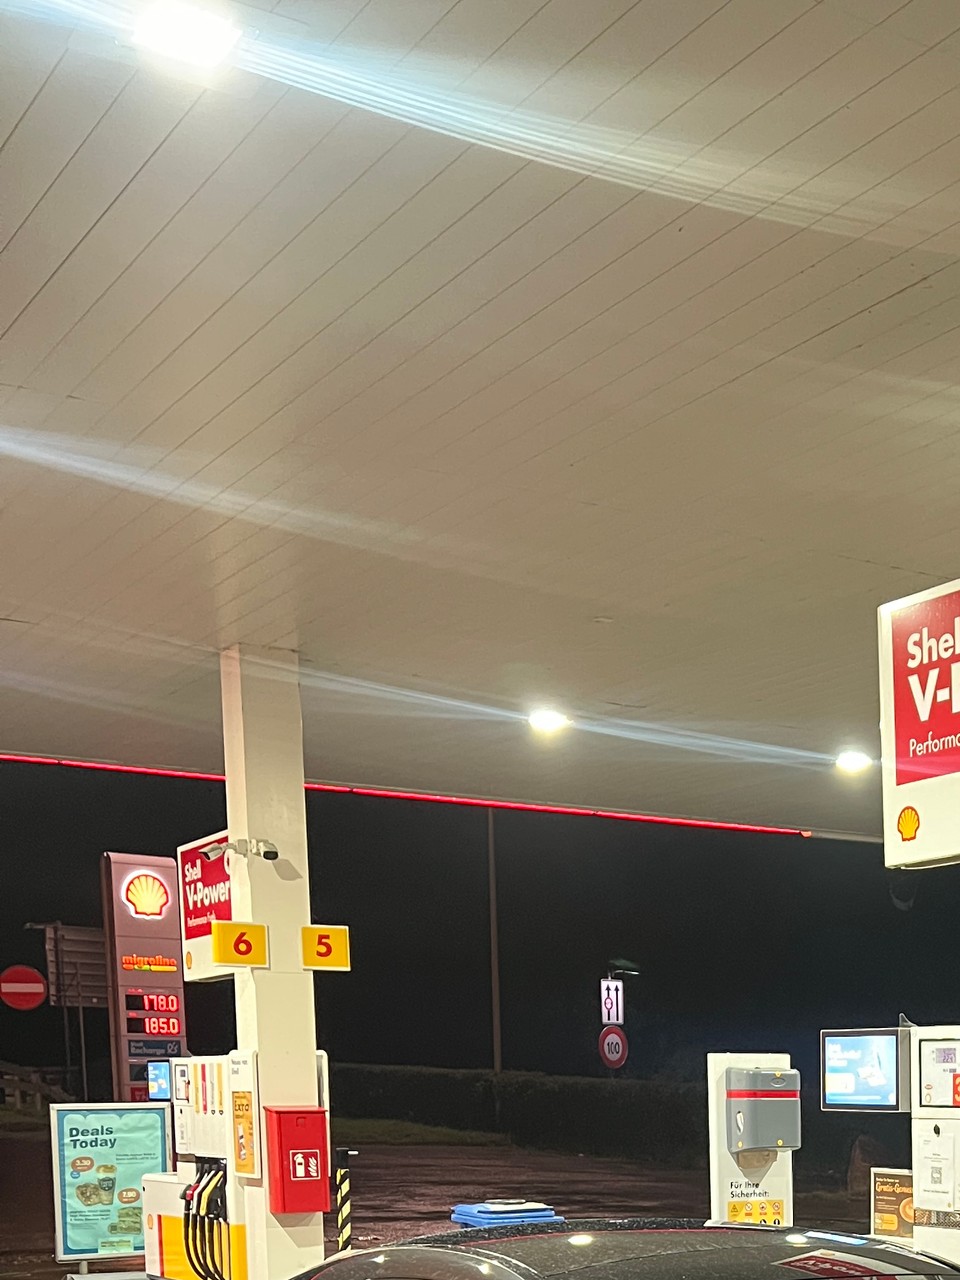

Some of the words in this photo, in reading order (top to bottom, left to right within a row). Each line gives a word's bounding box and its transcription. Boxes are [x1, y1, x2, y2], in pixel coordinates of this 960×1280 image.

[184, 859, 202, 882] Shell
[185, 880, 230, 910] V-Power
[233, 932, 253, 956] 6
[316, 934, 333, 957] 5
[122, 953, 178, 967] migrolino
[143, 994, 179, 1012] 178.0
[144, 1017, 179, 1035] 185.0
[606, 1041, 620, 1055] 100
[69, 1125, 114, 1138] Deals
[69, 1137, 117, 1149] Today
[730, 1181, 743, 1189] Für
[745, 1181, 760, 1189] Ihre
